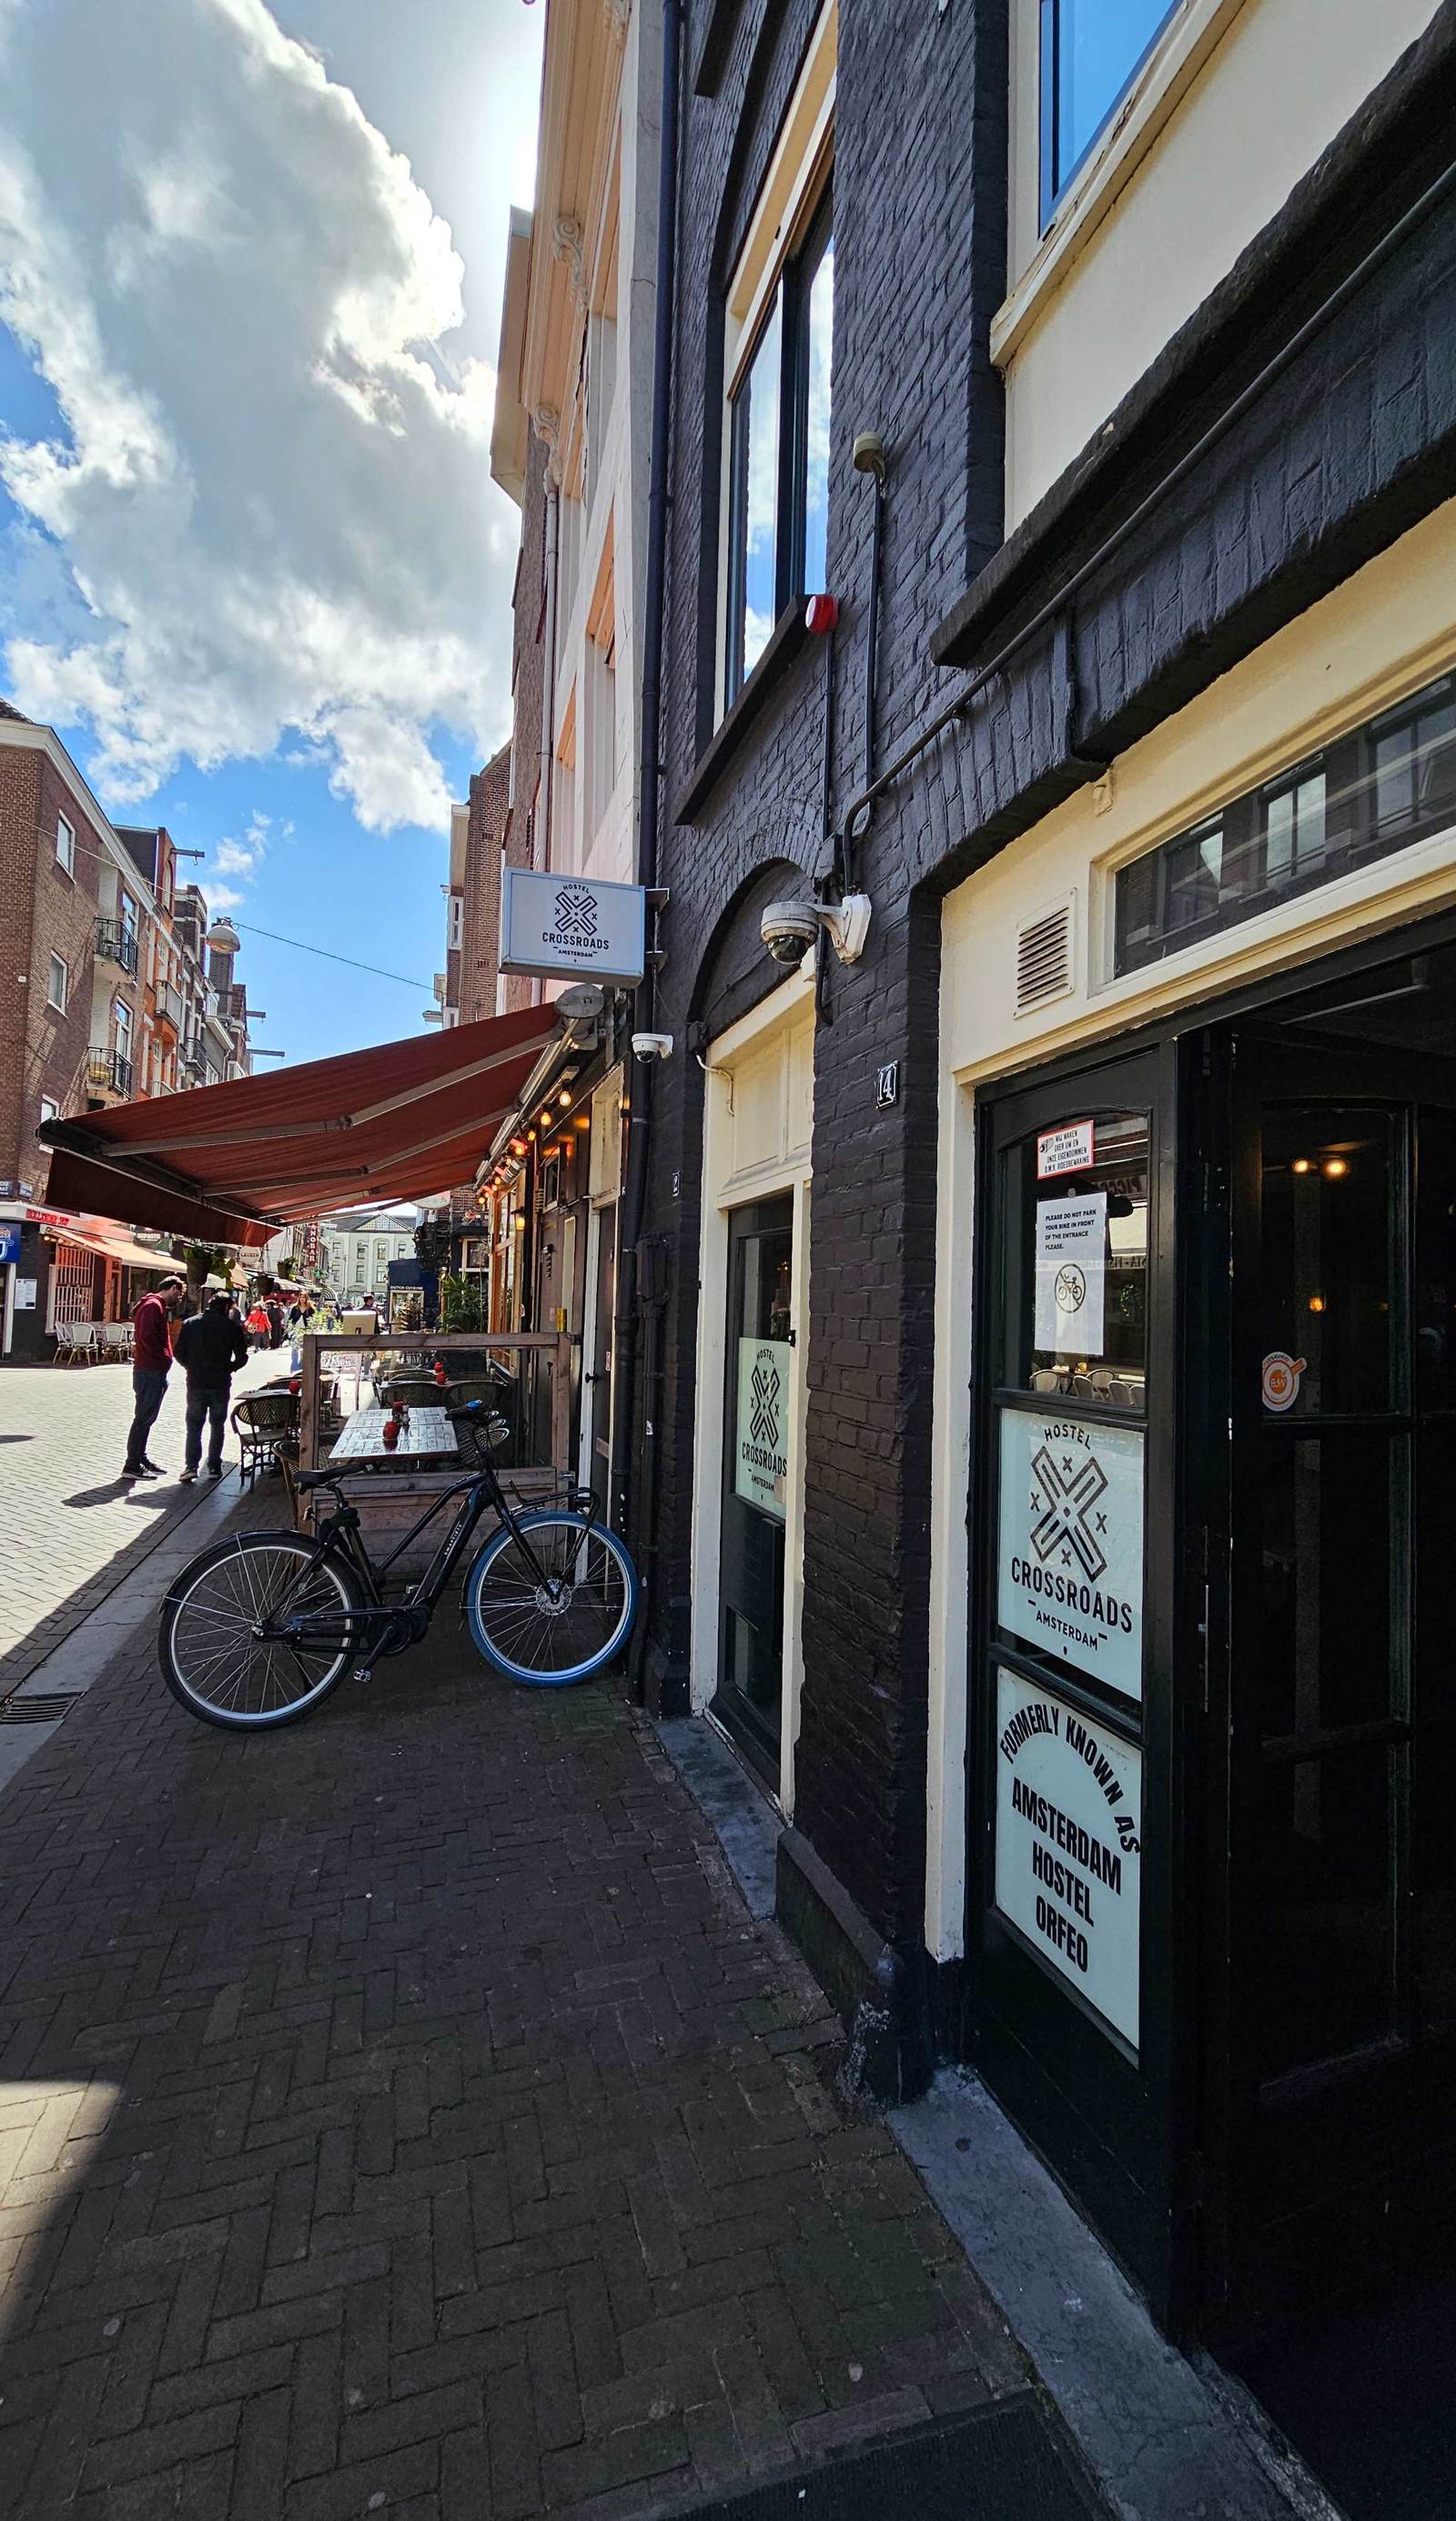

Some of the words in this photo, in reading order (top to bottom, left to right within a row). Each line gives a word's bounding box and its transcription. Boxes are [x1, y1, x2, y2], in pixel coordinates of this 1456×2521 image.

[562, 884, 591, 894] HOSTEL
[542, 932, 610, 950] CROSSROADS
[558, 948, 593, 958] AMSTERDAM
[309, 1223, 318, 1262] ANOBAR
[1063, 1230, 1089, 1239] ENTRANCE
[757, 1349, 775, 1363] HOSTEL
[1044, 1423, 1092, 1451] HOSTEL
[742, 1442, 787, 1477] CROSSROADS
[751, 1474, 775, 1493] AMSTERDAM
[1011, 1556, 1133, 1634] CROSSROADS
[1036, 1609, 1097, 1651] AMSTERDAM
[1000, 1704, 1060, 1765] FORMERLY
[1065, 1716, 1124, 1807] KNOWN
[1114, 1815, 1140, 1854] AS
[1011, 1777, 1122, 1897] AMSTERDAM
[1032, 1840, 1094, 1928] HOSTEL
[1036, 1894, 1088, 1973] ORFEO
